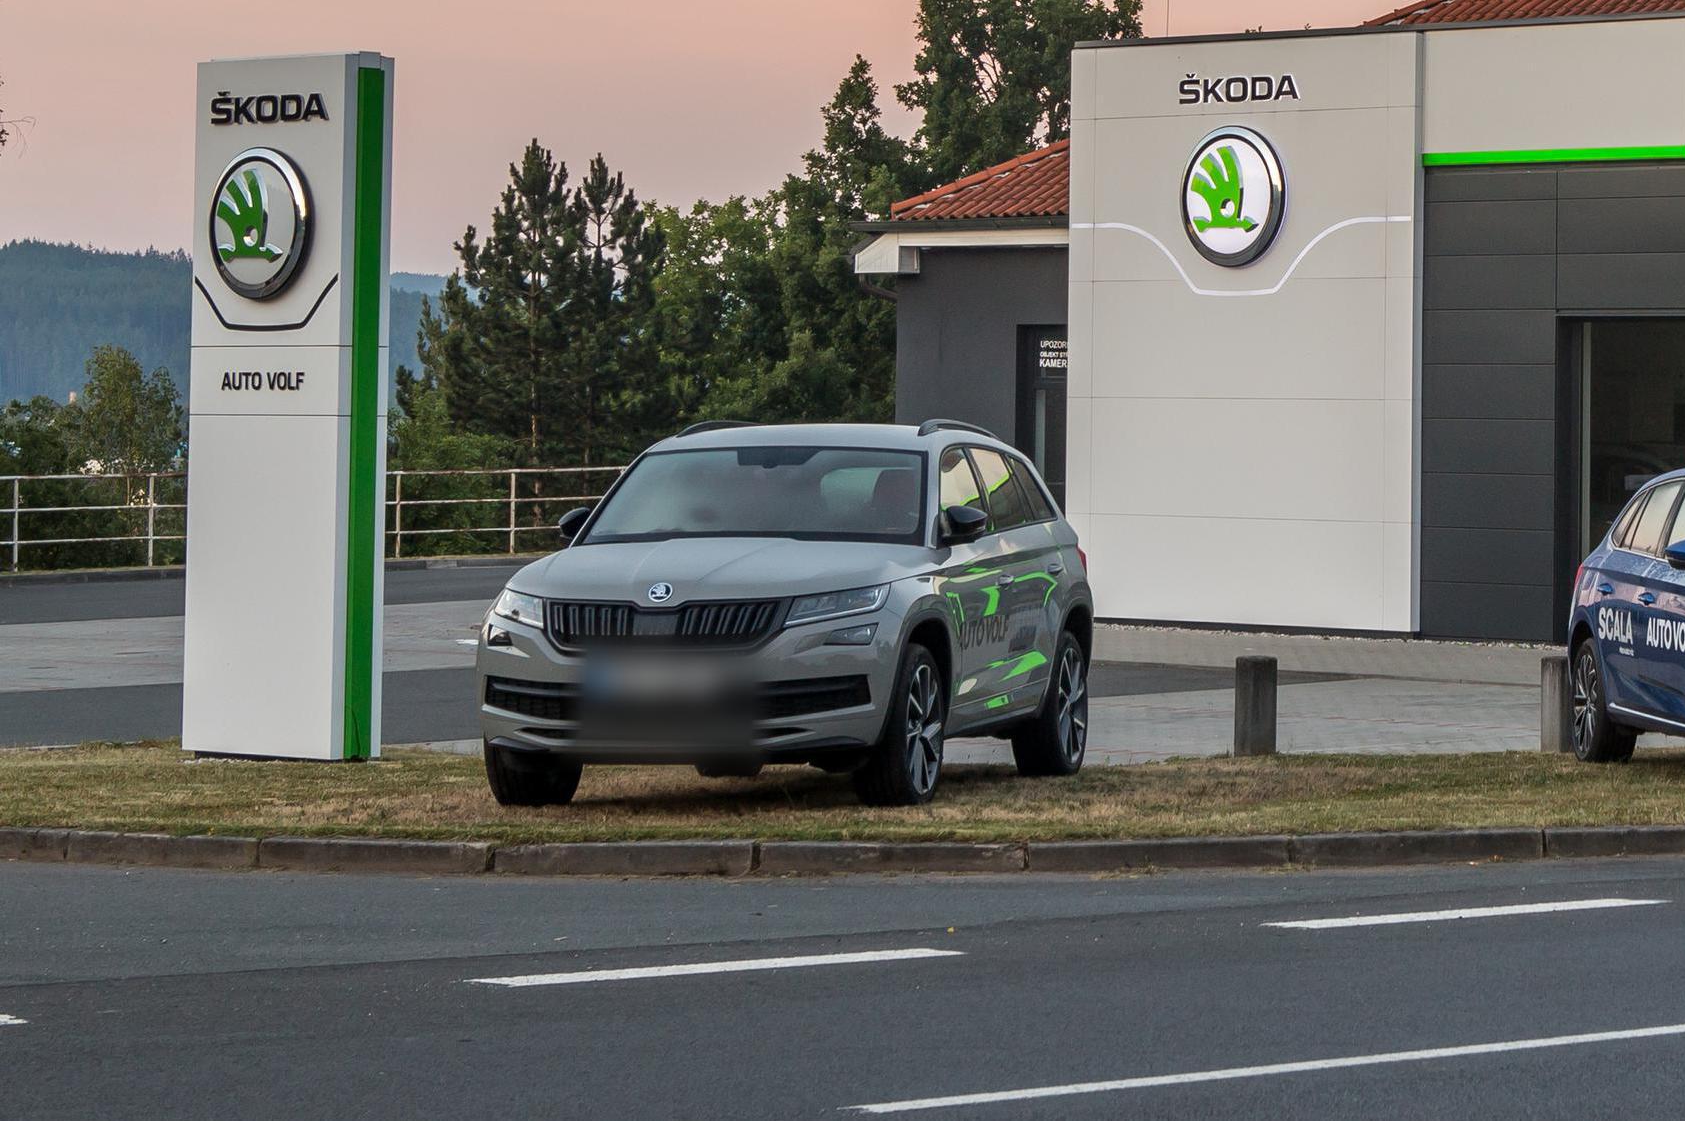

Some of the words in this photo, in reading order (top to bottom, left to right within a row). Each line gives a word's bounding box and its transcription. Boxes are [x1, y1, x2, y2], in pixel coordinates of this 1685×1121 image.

[1179, 73, 1300, 104] ŠKODA
[211, 91, 329, 124] ŠKODA
[221, 372, 262, 391] AUTO
[266, 372, 305, 391] VOLF
[1598, 606, 1634, 645] SCALA
